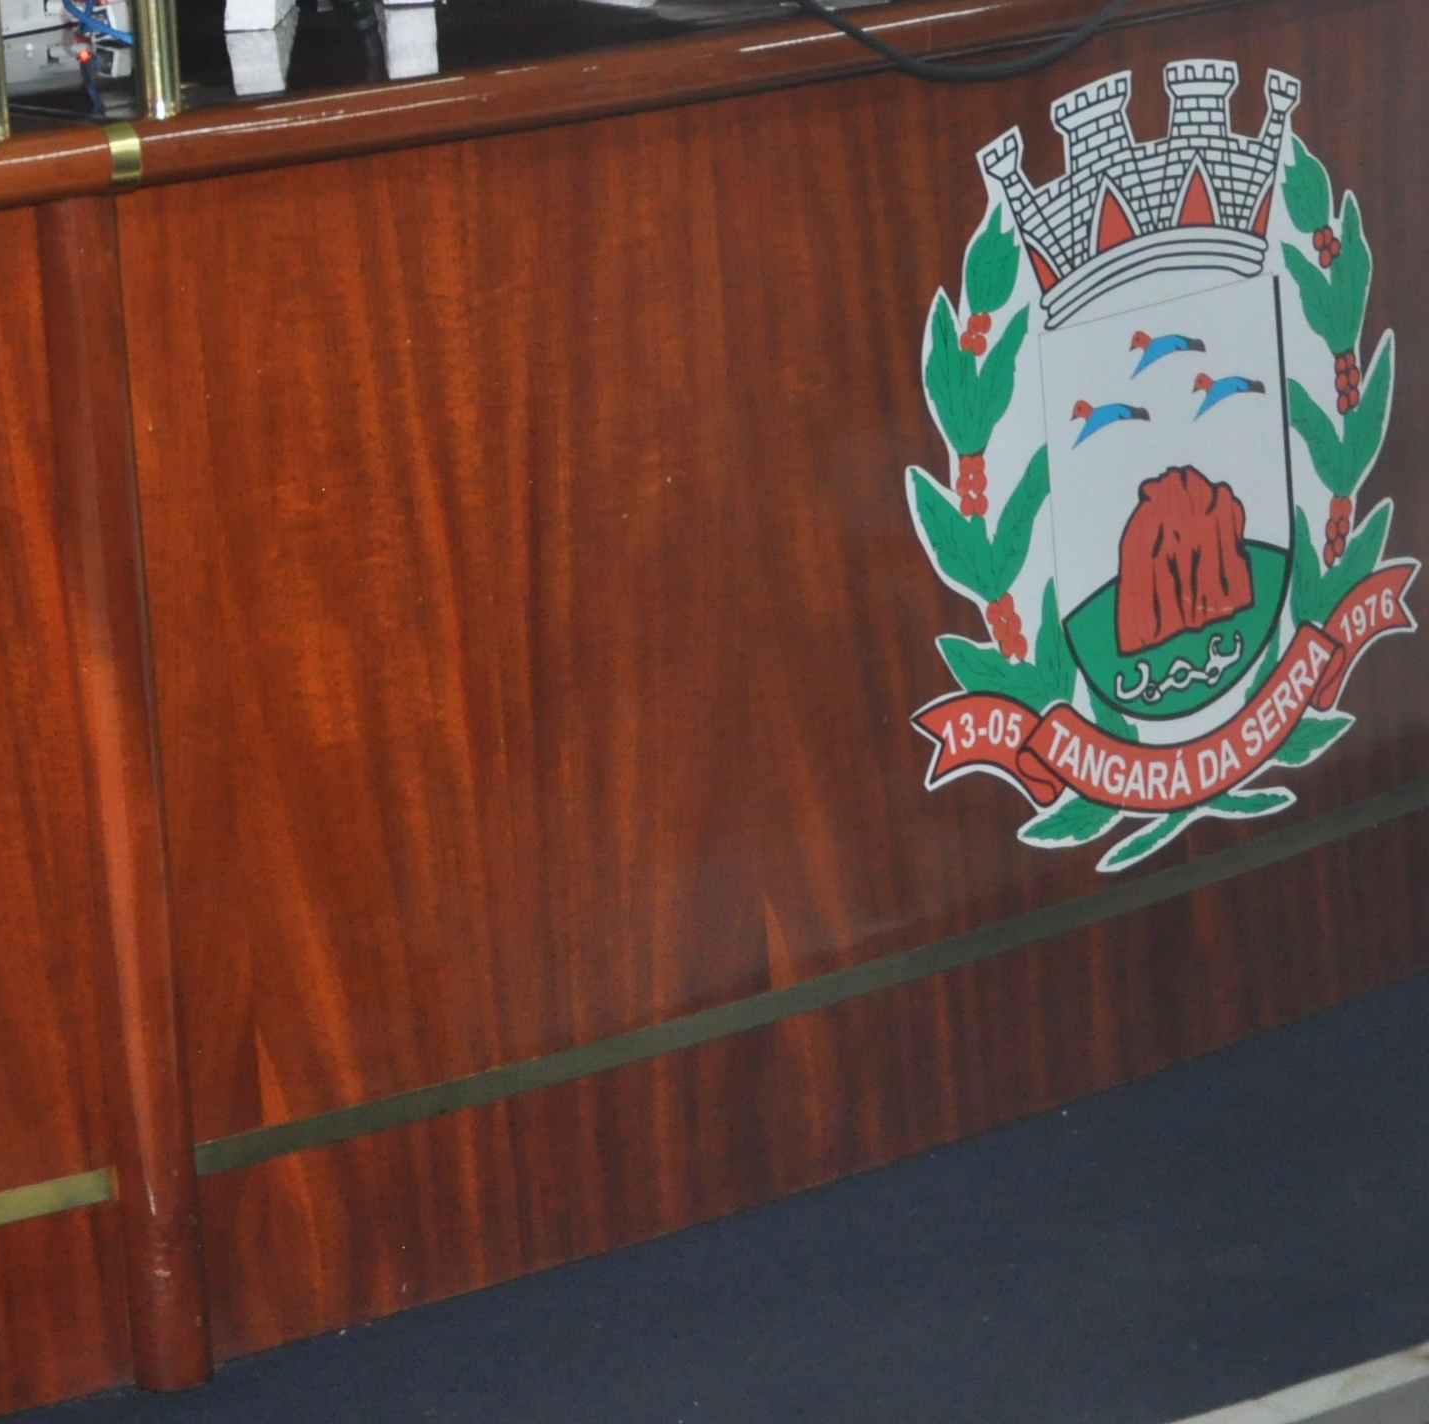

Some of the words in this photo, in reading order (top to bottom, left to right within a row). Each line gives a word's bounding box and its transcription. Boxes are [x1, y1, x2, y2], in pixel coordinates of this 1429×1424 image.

[941, 707, 1023, 756] 13-05
[1046, 719, 1193, 801] TANGARÁ
[1197, 738, 1241, 791] DA
[1240, 639, 1331, 757] SERRA
[1339, 587, 1395, 645] 1976
